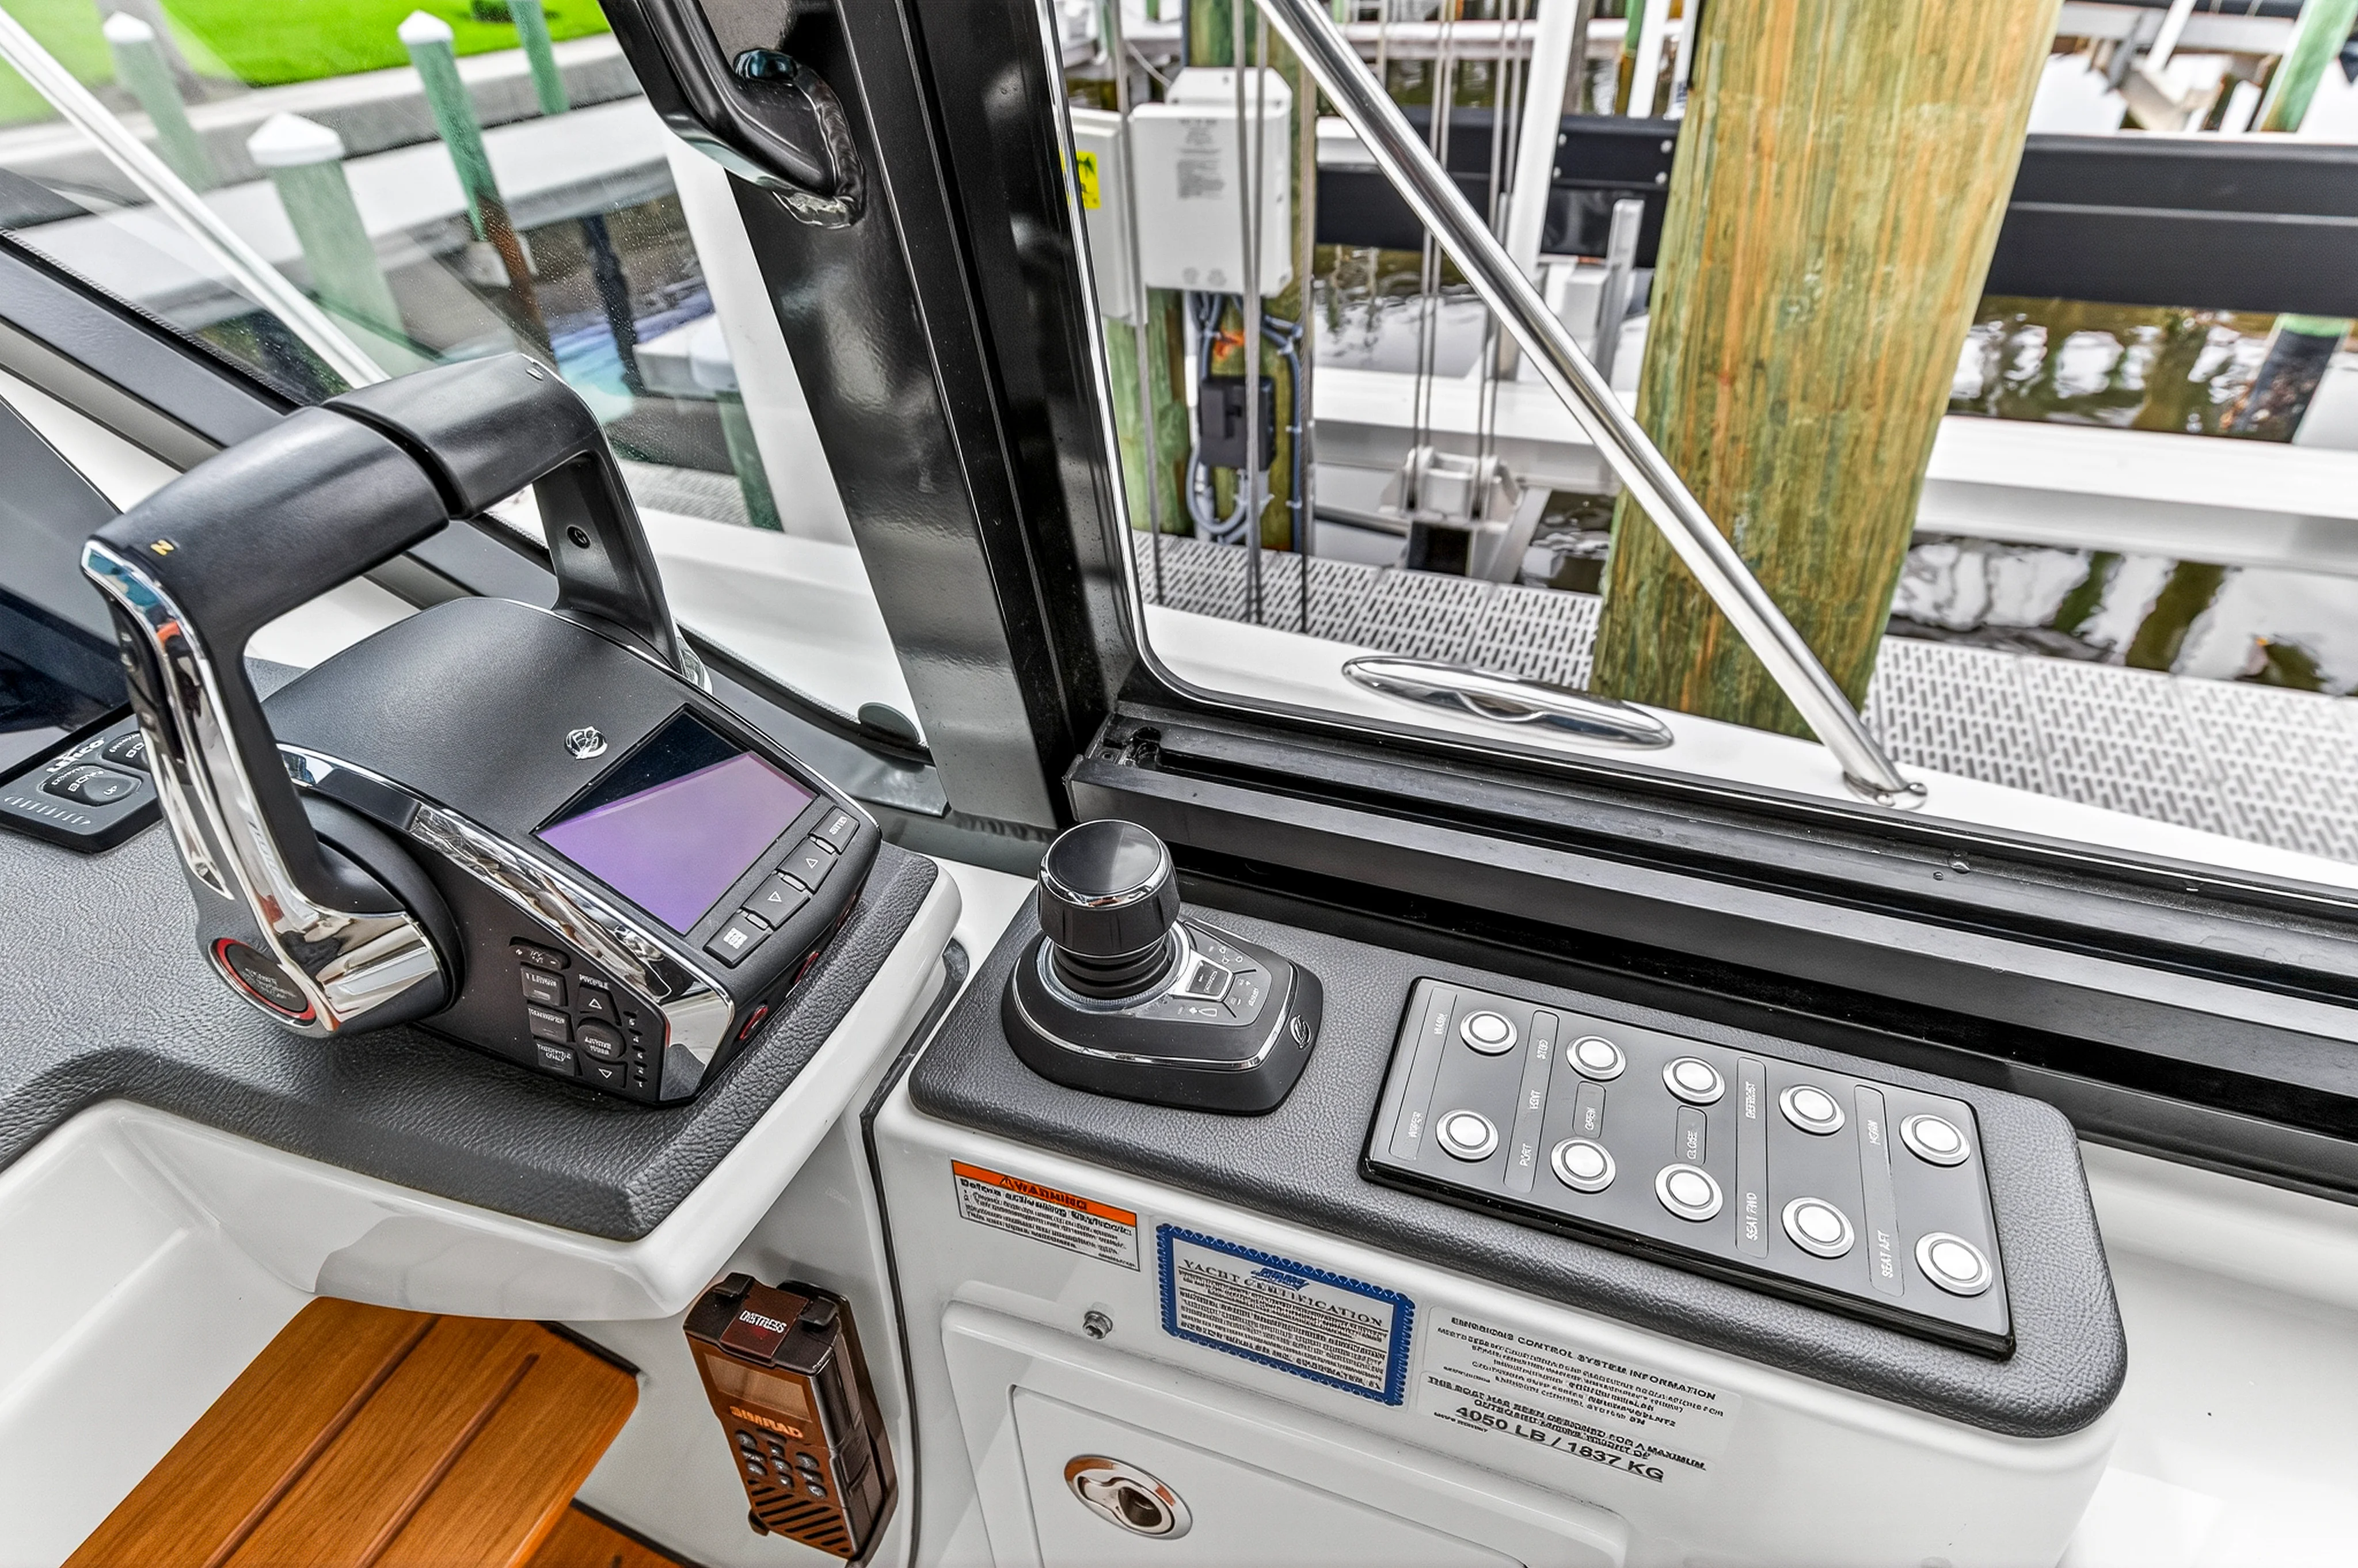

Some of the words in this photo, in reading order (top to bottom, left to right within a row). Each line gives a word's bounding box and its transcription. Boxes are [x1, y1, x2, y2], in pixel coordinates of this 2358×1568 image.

[1584, 1106, 1597, 1131] OPEN
[1519, 1143, 1533, 1167] PORT
[1686, 1130, 1699, 1160] CLOSE
[960, 1178, 1002, 1197] Before
[1014, 1181, 1087, 1211] WARNING
[1745, 1215, 1759, 1242] SEAT
[1876, 1230, 1892, 1251] AFT
[1881, 1251, 1895, 1279] SEAT
[1182, 1258, 1240, 1283] YACHT
[1243, 1277, 1384, 1327] CERTIFICATION
[739, 1310, 787, 1334] DISTRESS
[1451, 1317, 1514, 1341] EMISSIONS
[1518, 1337, 1573, 1360] CONTROL
[1577, 1354, 1628, 1374] SYSTEM
[1630, 1369, 1716, 1401] INFORMATION
[729, 1405, 804, 1438] SIMRAD
[1428, 1375, 1452, 1390] THIS
[1455, 1384, 1485, 1400] BOAT
[1488, 1394, 1511, 1409] HAS
[1513, 1403, 1545, 1419] BEEN
[1547, 1414, 1606, 1438] DESIGNED
[1609, 1433, 1634, 1447] FOR
[1635, 1443, 1646, 1451] A
[1647, 1445, 1706, 1471] MAXIMUM
[1474, 1399, 1539, 1425] OUTBOARD
[1633, 1449, 1651, 1460] OF
[1456, 1406, 1508, 1430] 4050
[1515, 1424, 1546, 1443] LB
[1550, 1437, 1562, 1447] /
[1568, 1441, 1622, 1465] 1837
[1628, 1460, 1664, 1482] KG
